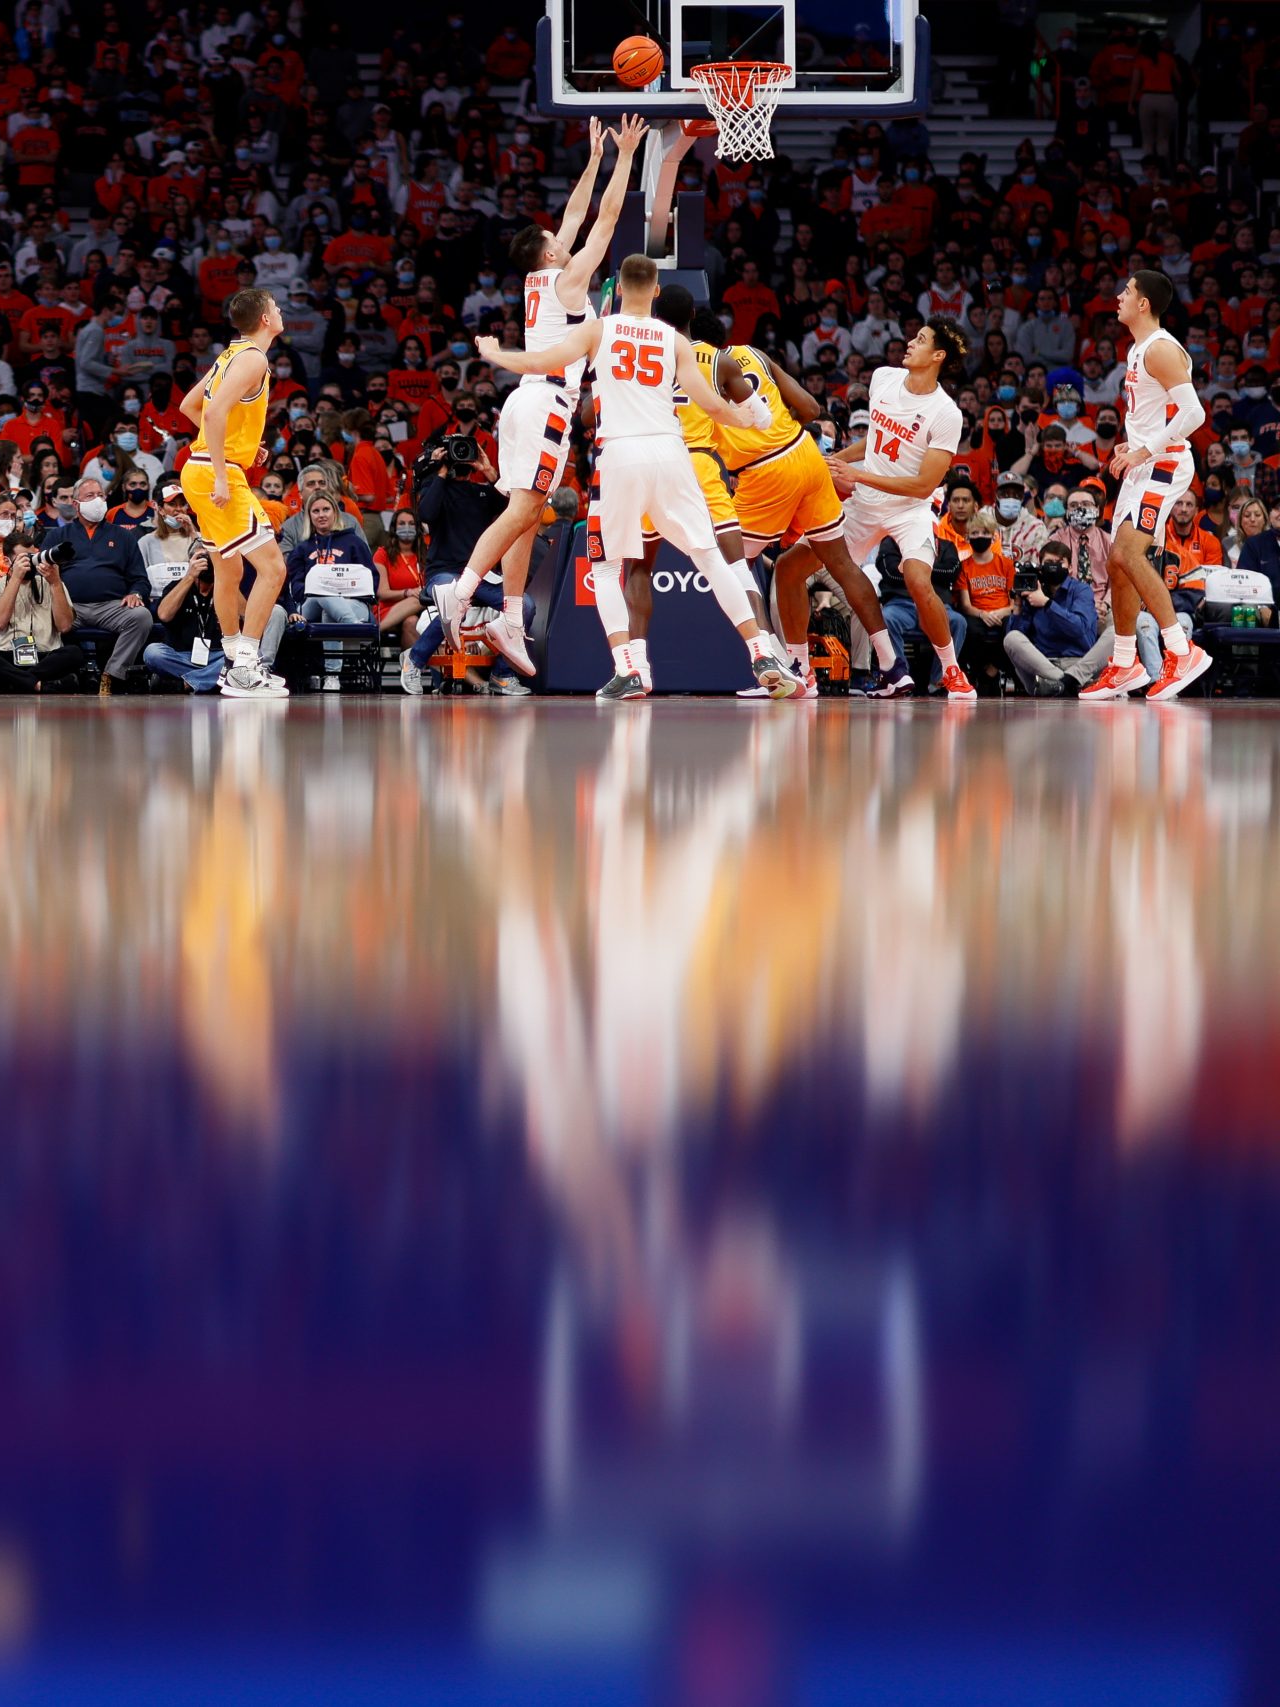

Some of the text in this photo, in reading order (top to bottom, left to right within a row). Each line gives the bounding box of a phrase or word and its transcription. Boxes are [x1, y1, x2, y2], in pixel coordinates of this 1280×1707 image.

[526, 291, 541, 328] 0
[614, 323, 664, 342] BOEHEIM
[610, 339, 664, 387] 35
[870, 408, 917, 443] ORANGE
[873, 429, 902, 464] 14
[536, 469, 553, 492] S
[1141, 507, 1157, 530] S
[588, 536, 602, 559] S
[650, 571, 709, 592] OYO
